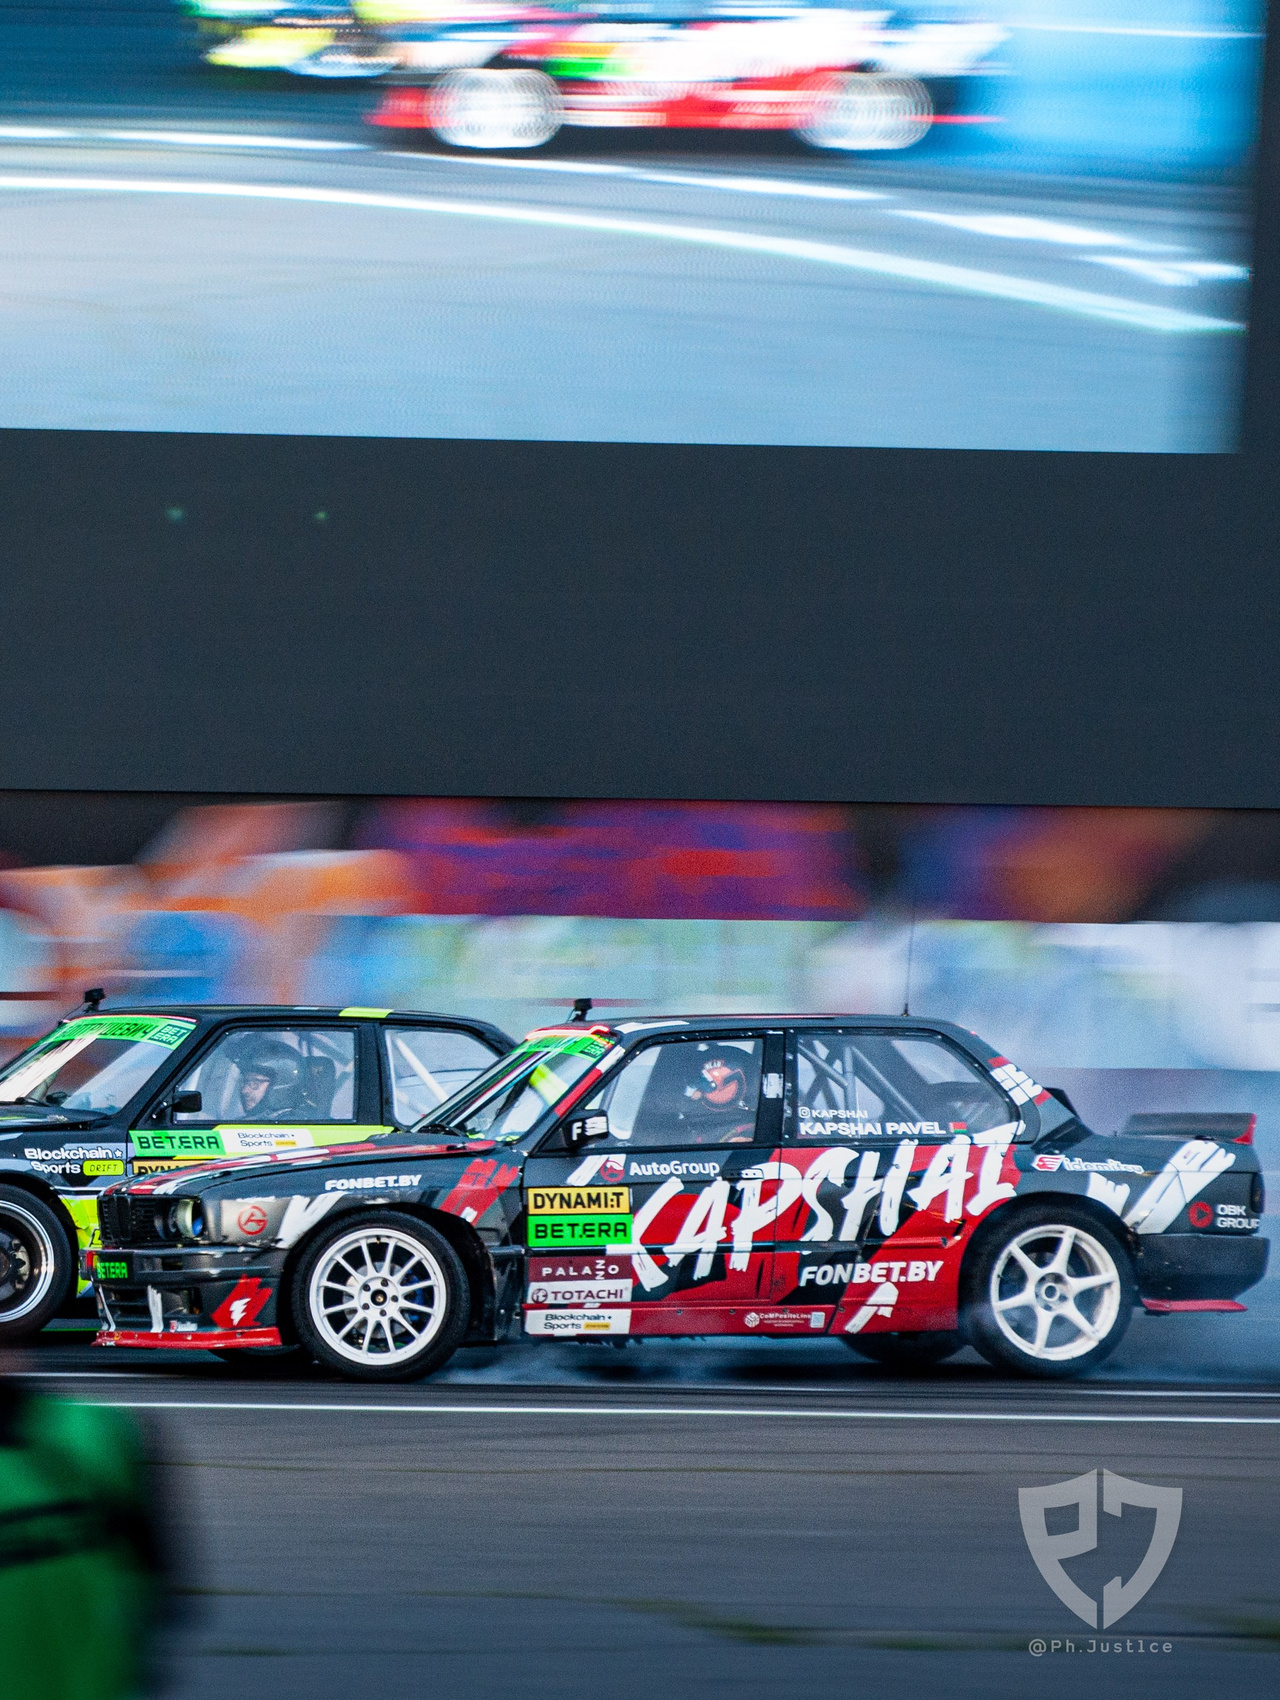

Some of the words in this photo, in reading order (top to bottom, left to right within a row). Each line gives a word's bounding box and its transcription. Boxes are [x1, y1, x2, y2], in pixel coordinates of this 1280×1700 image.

[812, 1109, 868, 1119] KAPSHAI
[799, 1122, 882, 1135] KAPSHAI
[885, 1121, 946, 1135] PAVEL
[24, 1146, 113, 1160] Blockchain
[30, 1161, 81, 1174] Sports
[89, 1164, 118, 1173] DRIFT
[629, 1160, 720, 1177] AutoGroup
[324, 1174, 422, 1191] FONBET.BY
[630, 1120, 1026, 1291] KAPSHAI
[1217, 1204, 1247, 1216] OBK
[1217, 1216, 1260, 1229] GROUP
[534, 1222, 628, 1239] BET.ERA
[799, 1260, 945, 1287] FONBET.BY
[551, 1288, 624, 1301] TOTACHI
[544, 1313, 606, 1321] Blockchain
[543, 1322, 582, 1331] Sports
